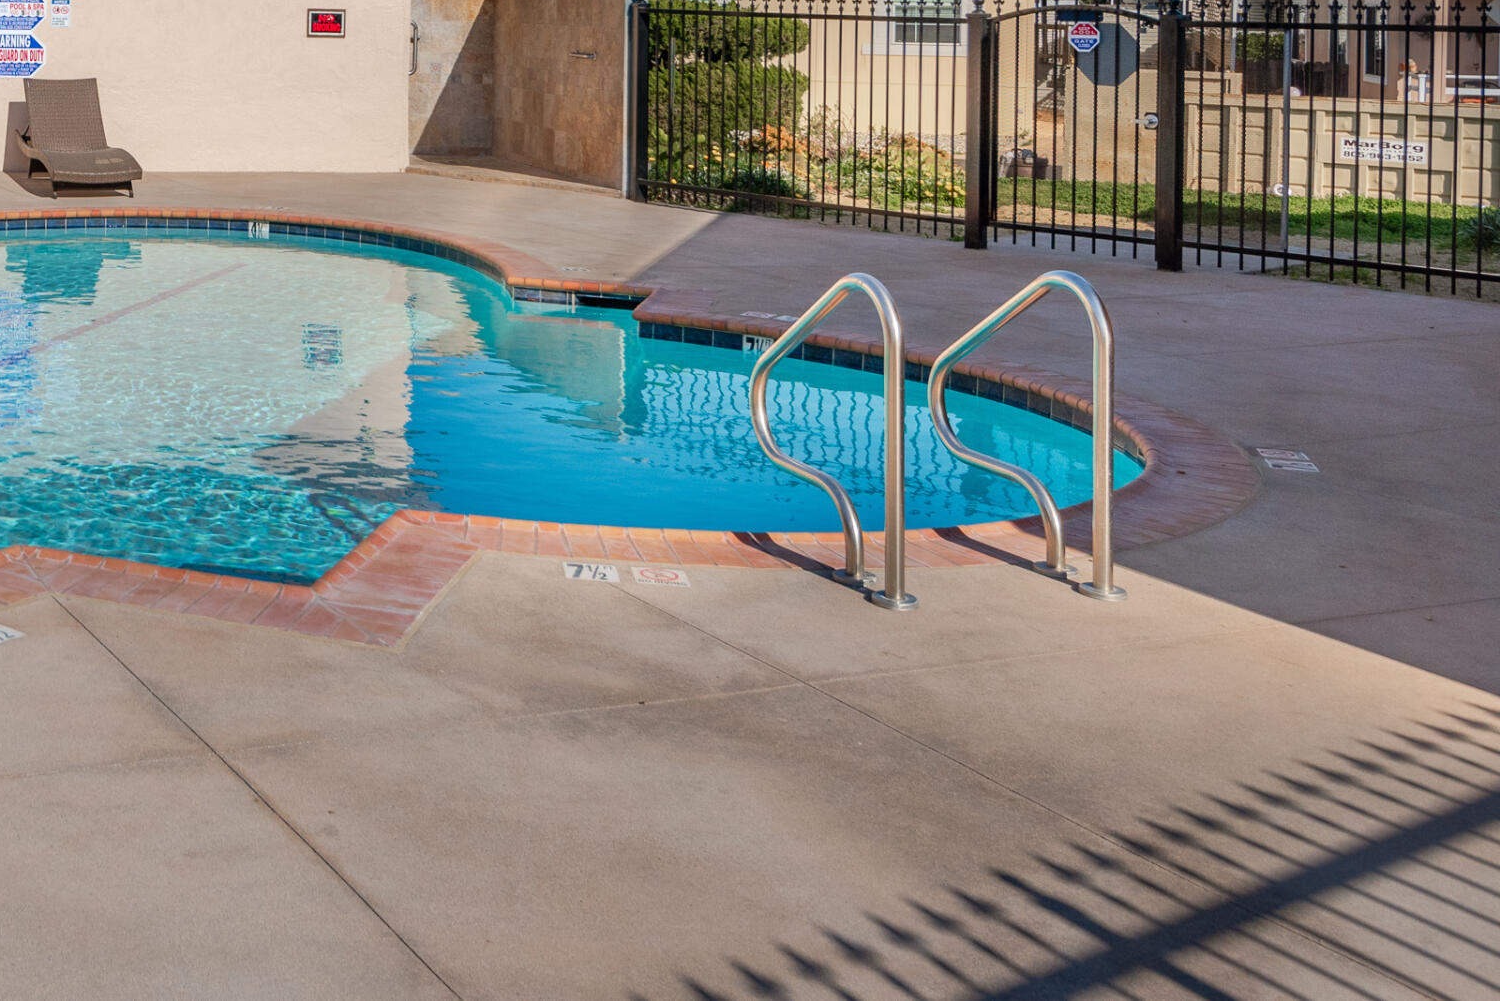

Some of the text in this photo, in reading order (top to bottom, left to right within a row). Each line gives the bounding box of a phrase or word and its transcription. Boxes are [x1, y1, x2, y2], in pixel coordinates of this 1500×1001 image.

[318, 14, 336, 22] NO
[312, 22, 341, 32] SMOKING
[19, 49, 28, 61] ON
[30, 49, 45, 61] DUTY
